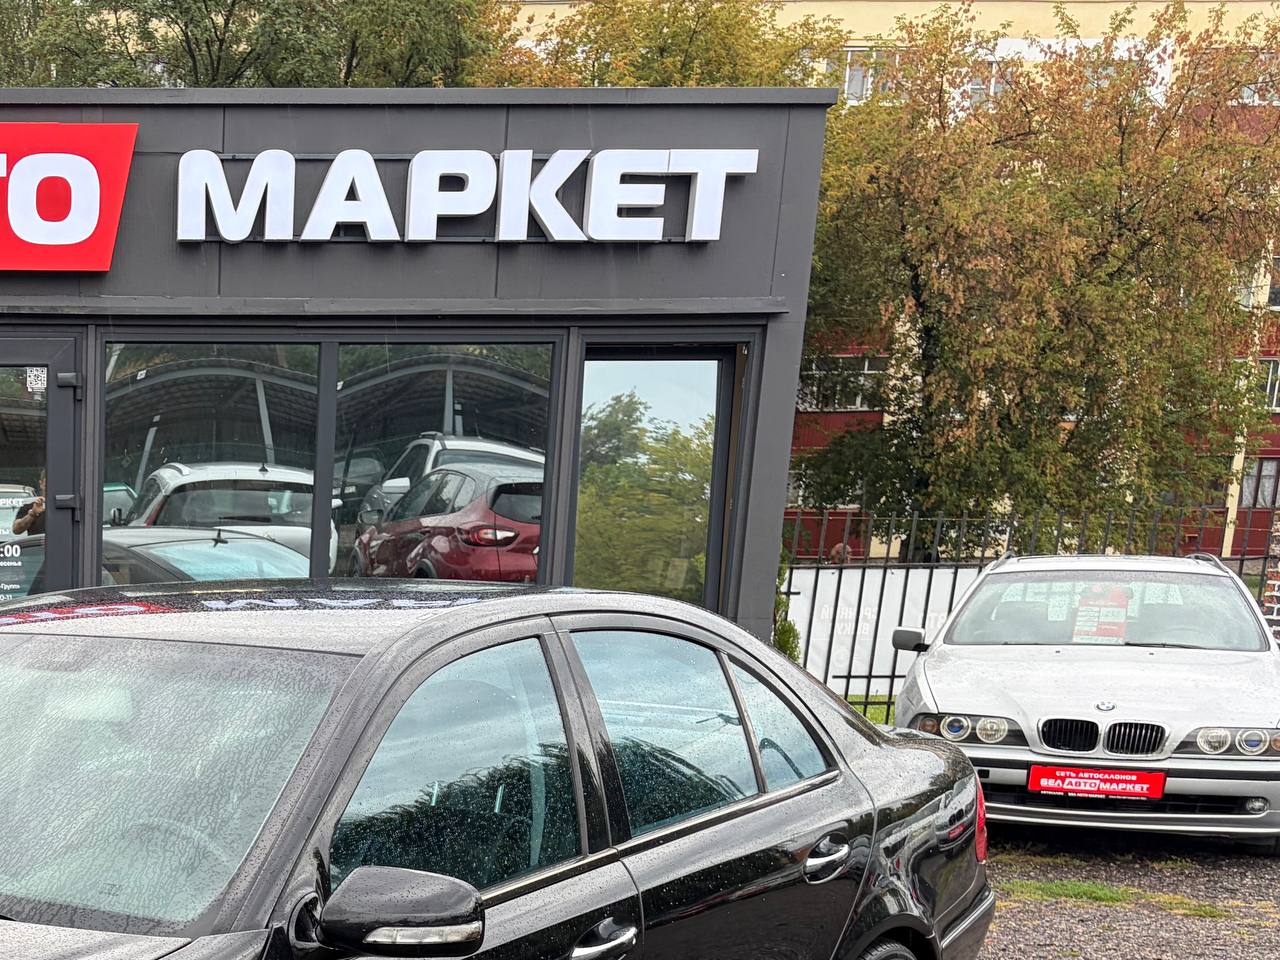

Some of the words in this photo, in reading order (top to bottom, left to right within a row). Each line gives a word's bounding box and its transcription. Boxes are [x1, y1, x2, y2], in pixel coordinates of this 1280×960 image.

[177, 149, 759, 243] МАРКЕТ
[1078, 772, 1137, 780] АВТОСАЛОНОВ
[1040, 778, 1063, 787] БЕЛ
[1065, 779, 1097, 789] АВТО
[1099, 782, 1150, 793] МАРКЕТ
